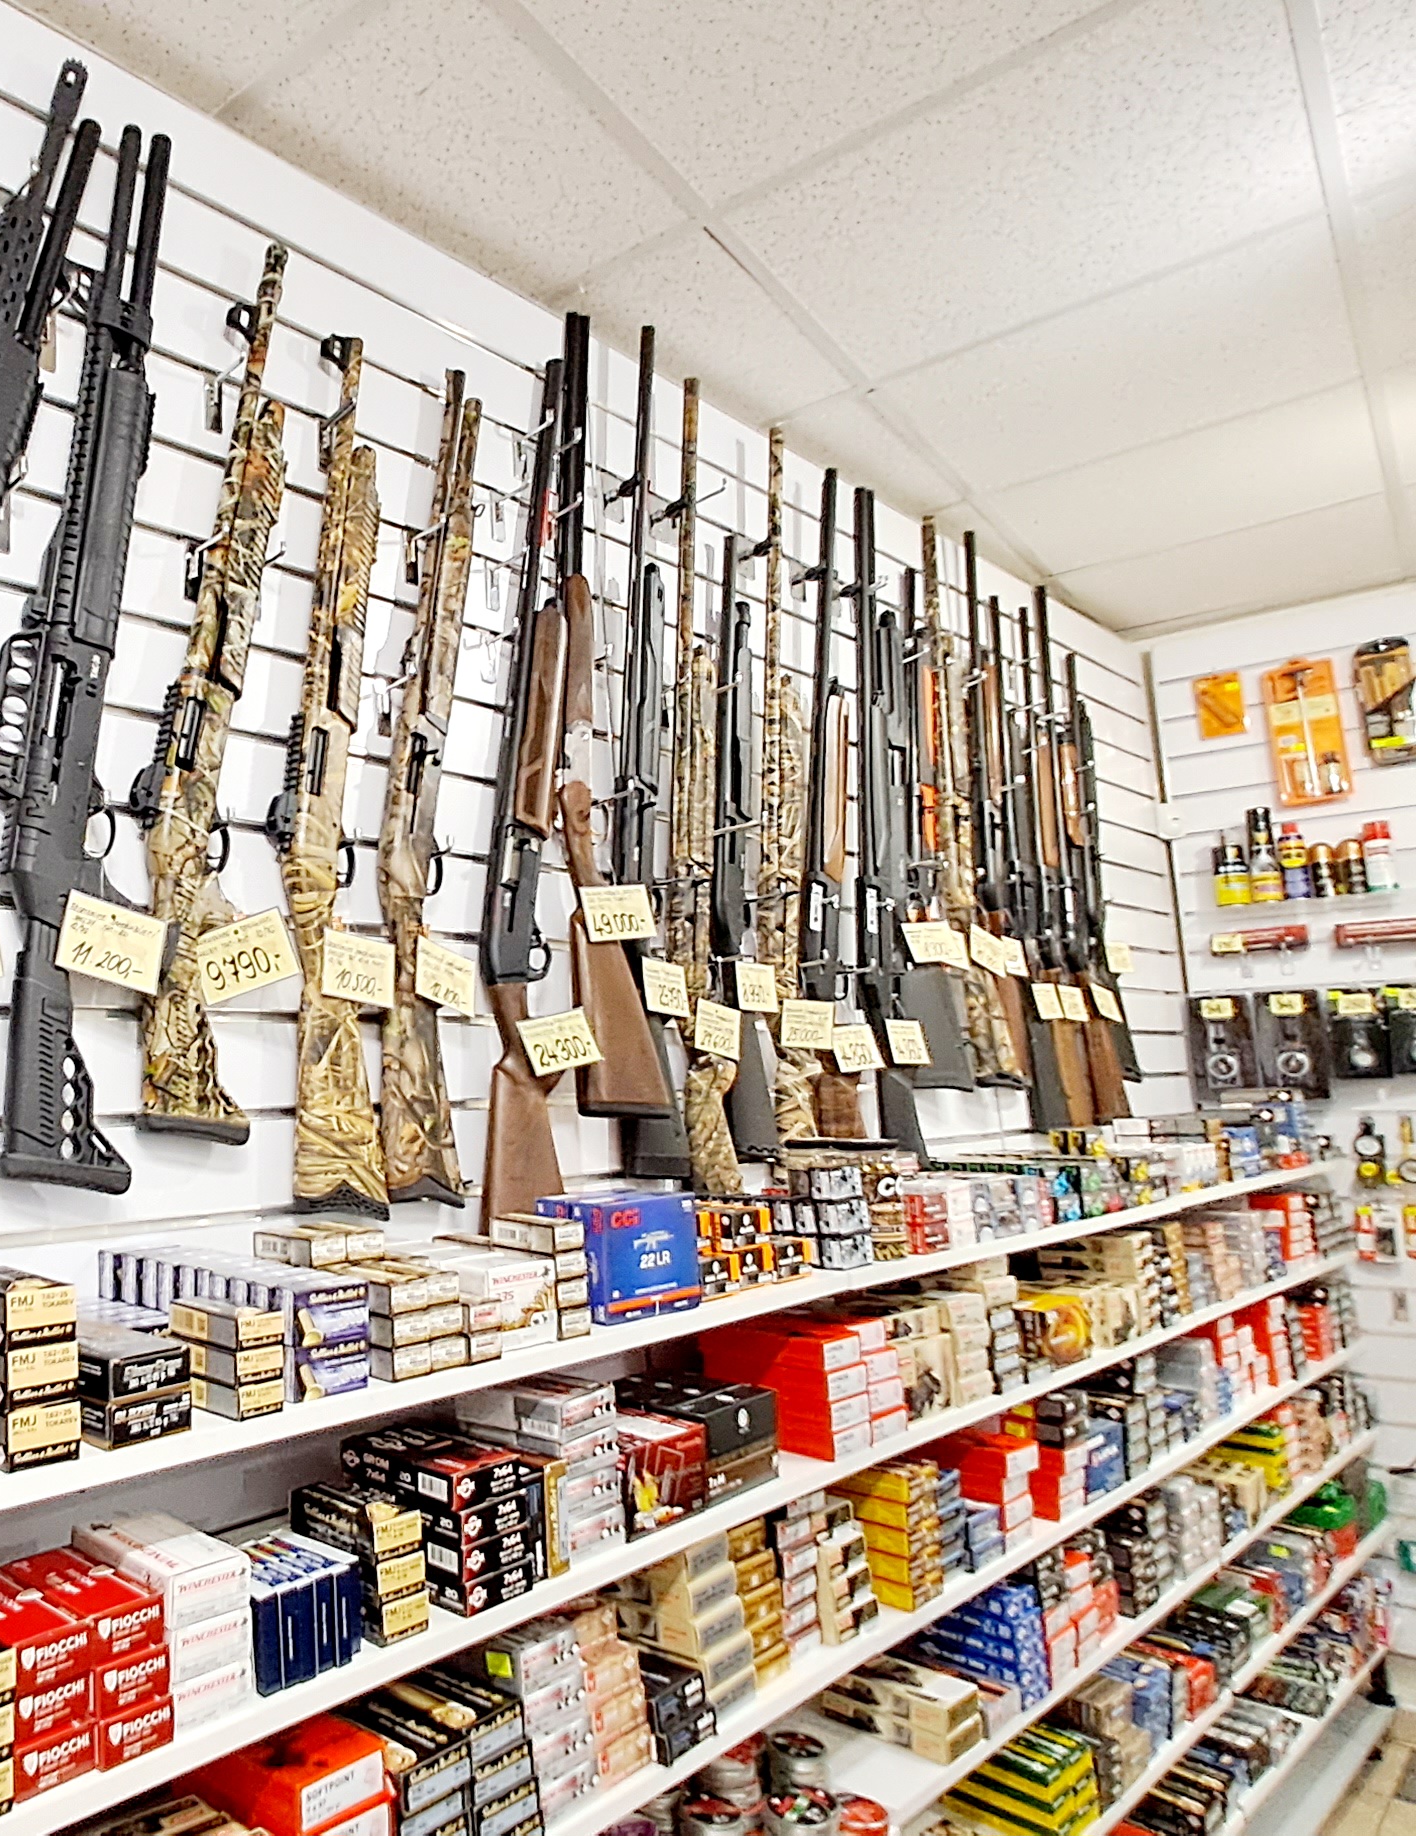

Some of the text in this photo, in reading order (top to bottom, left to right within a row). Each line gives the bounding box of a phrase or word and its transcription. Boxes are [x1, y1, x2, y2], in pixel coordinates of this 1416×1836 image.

[639, 1250, 671, 1270] 22 LR
[10, 1294, 35, 1308] FMJ
[11, 1353, 36, 1368] FMJ
[11, 1414, 38, 1430] FMJ
[112, 1604, 161, 1632] FIOCCHI
[36, 1632, 88, 1661] FIOCCHI
[117, 1654, 166, 1684] FIOCCHI
[34, 1679, 85, 1710] FIOCCHI
[122, 1706, 171, 1736] FIOCCHI
[38, 1731, 91, 1766] FIOCCHI
